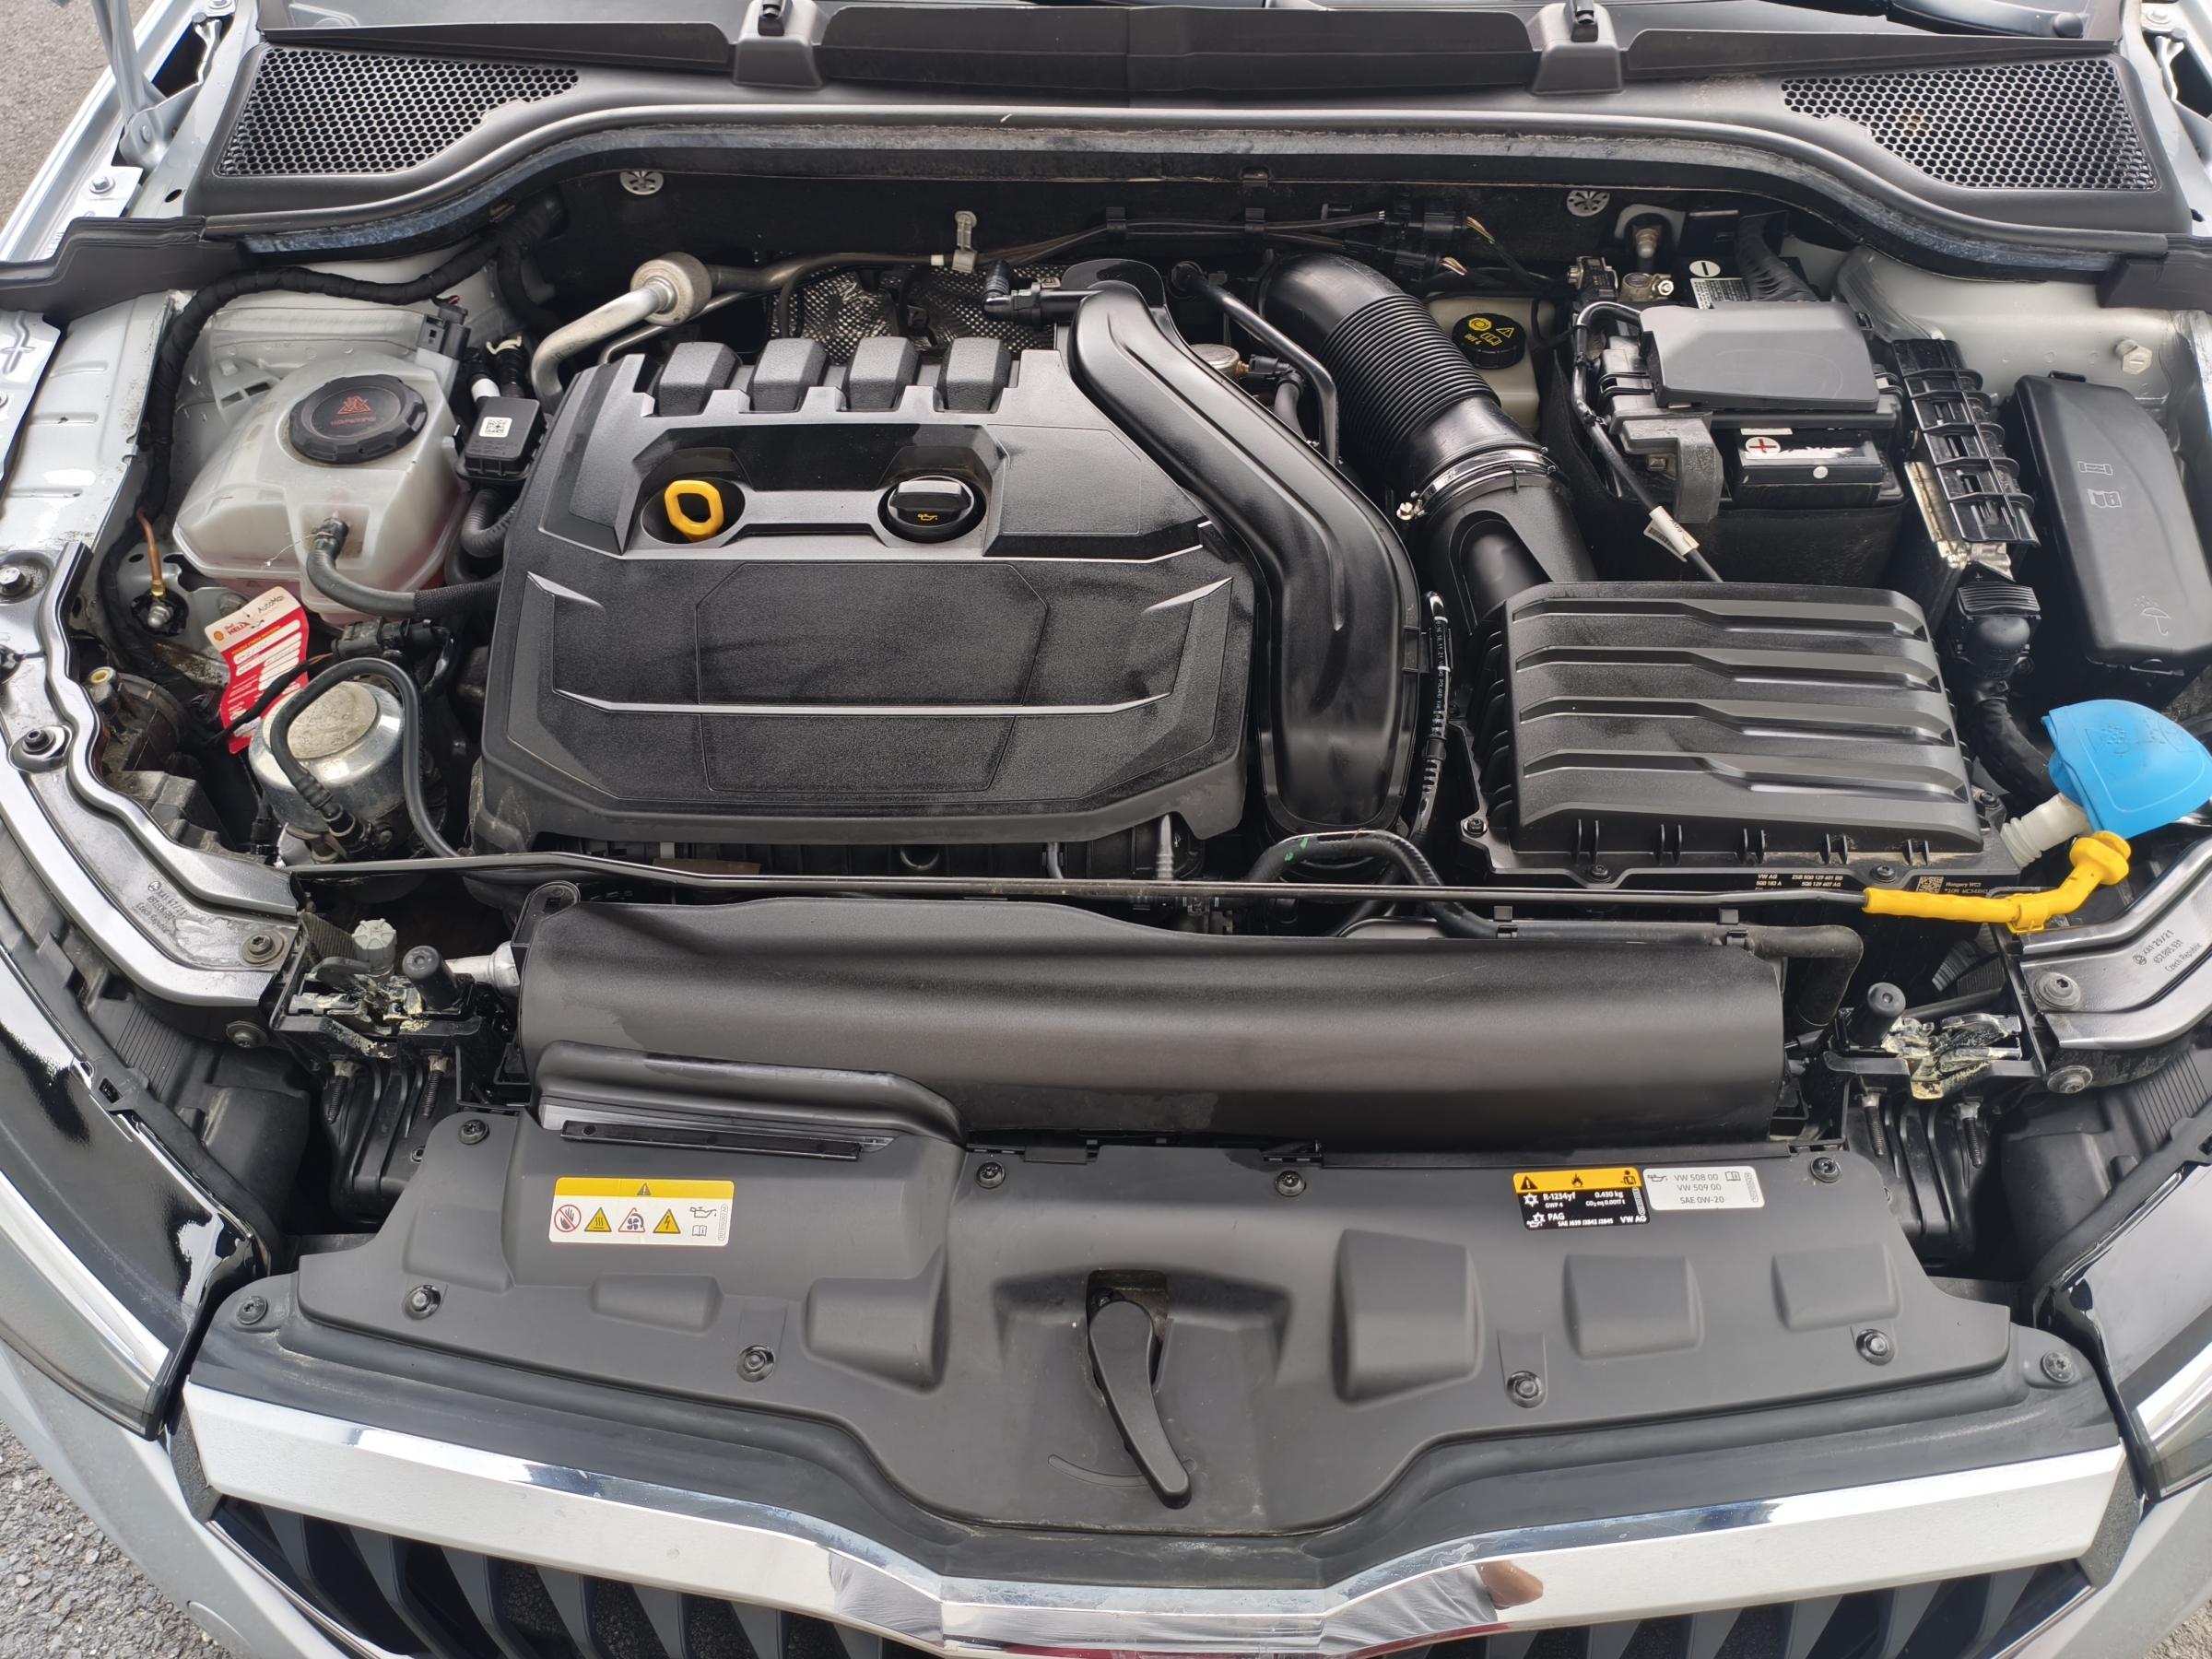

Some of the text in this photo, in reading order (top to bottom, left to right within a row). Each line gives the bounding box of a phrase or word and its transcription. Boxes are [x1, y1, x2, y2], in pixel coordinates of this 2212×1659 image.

[227, 622, 251, 635] HELIX
[1543, 1192, 1576, 1201] R-1234yf
[1614, 1191, 1624, 1199] kg
